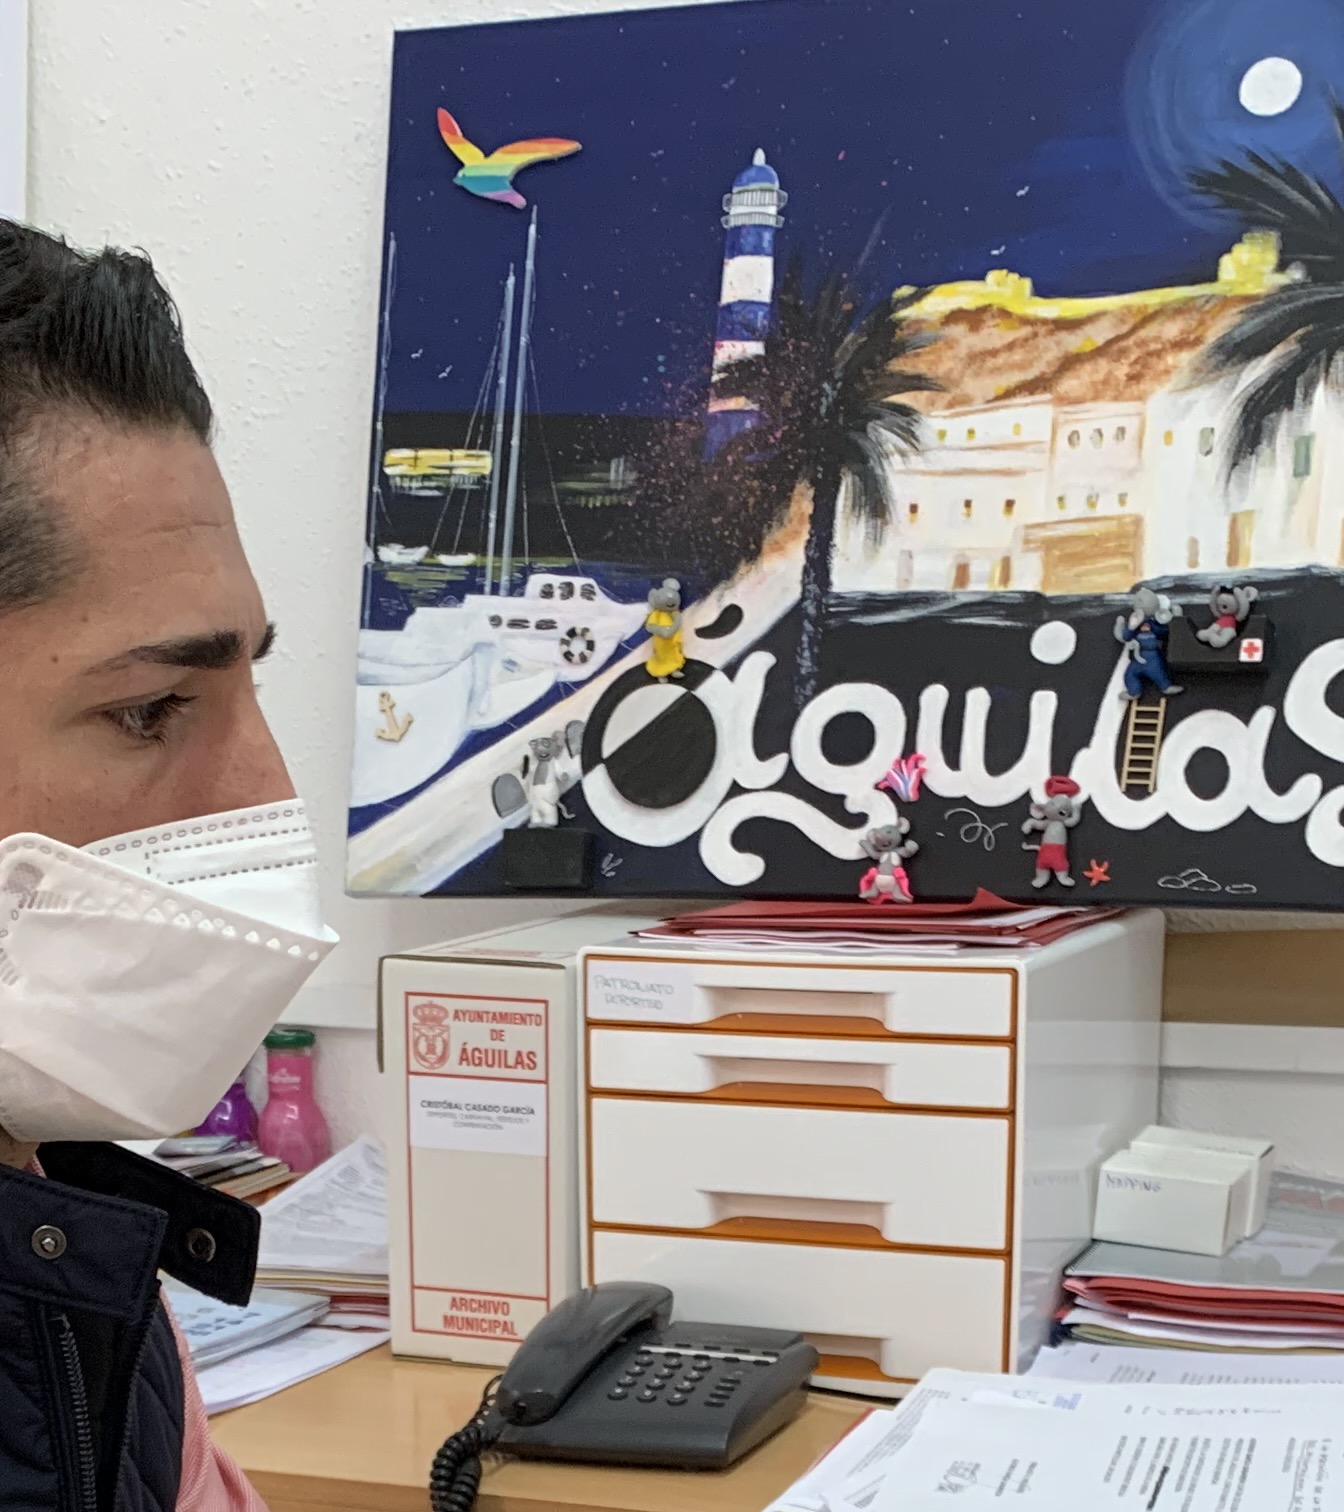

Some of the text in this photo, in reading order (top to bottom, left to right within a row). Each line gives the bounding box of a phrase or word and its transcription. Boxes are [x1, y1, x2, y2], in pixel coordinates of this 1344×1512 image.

[453, 1009, 542, 1027] AYUNTAMIENTO
[490, 1029, 505, 1042] DE
[459, 1042, 537, 1071] ÁGUILAS
[465, 1103, 500, 1113] CASADO
[450, 1297, 510, 1316] ARCHIVO
[443, 1315, 518, 1336] MUNICIPAL
